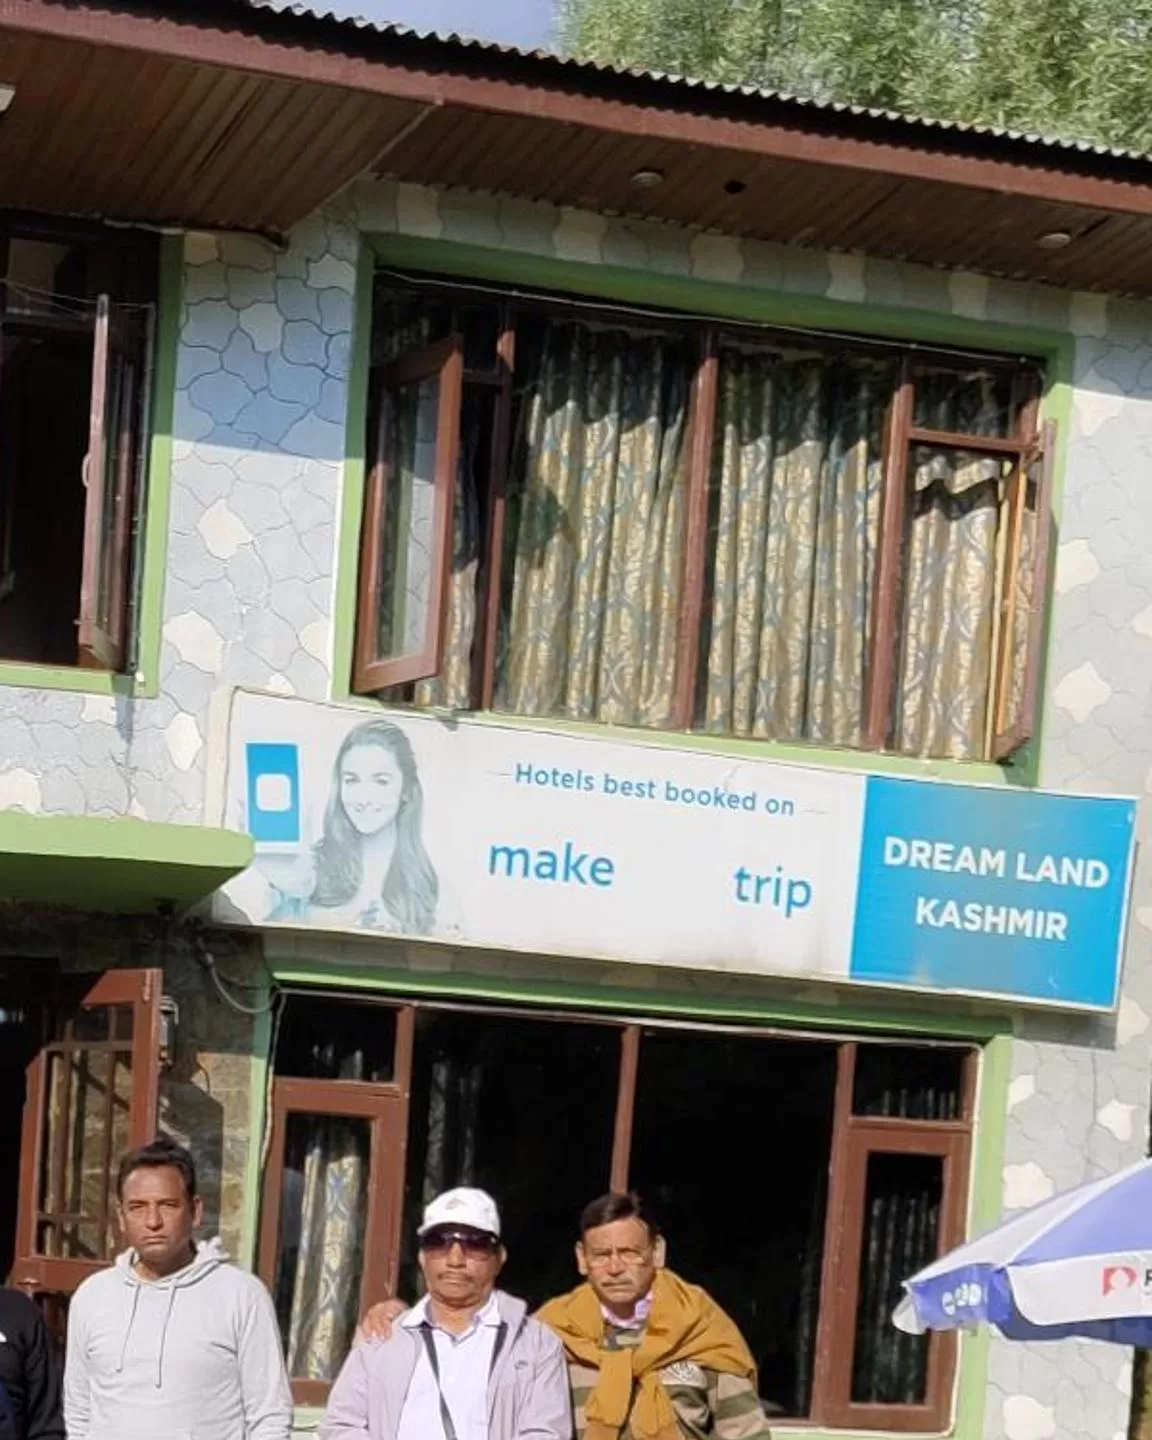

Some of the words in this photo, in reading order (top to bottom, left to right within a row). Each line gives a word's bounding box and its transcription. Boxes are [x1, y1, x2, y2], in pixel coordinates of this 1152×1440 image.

[515, 763, 595, 791] Hotels
[603, 774, 656, 798] best
[665, 781, 757, 811] booked
[765, 797, 795, 815] on
[488, 842, 615, 887] make
[734, 866, 813, 918] trip
[884, 836, 1005, 878] DREAM
[1016, 853, 1109, 888] LAND
[915, 897, 1068, 941] KASHMIR
